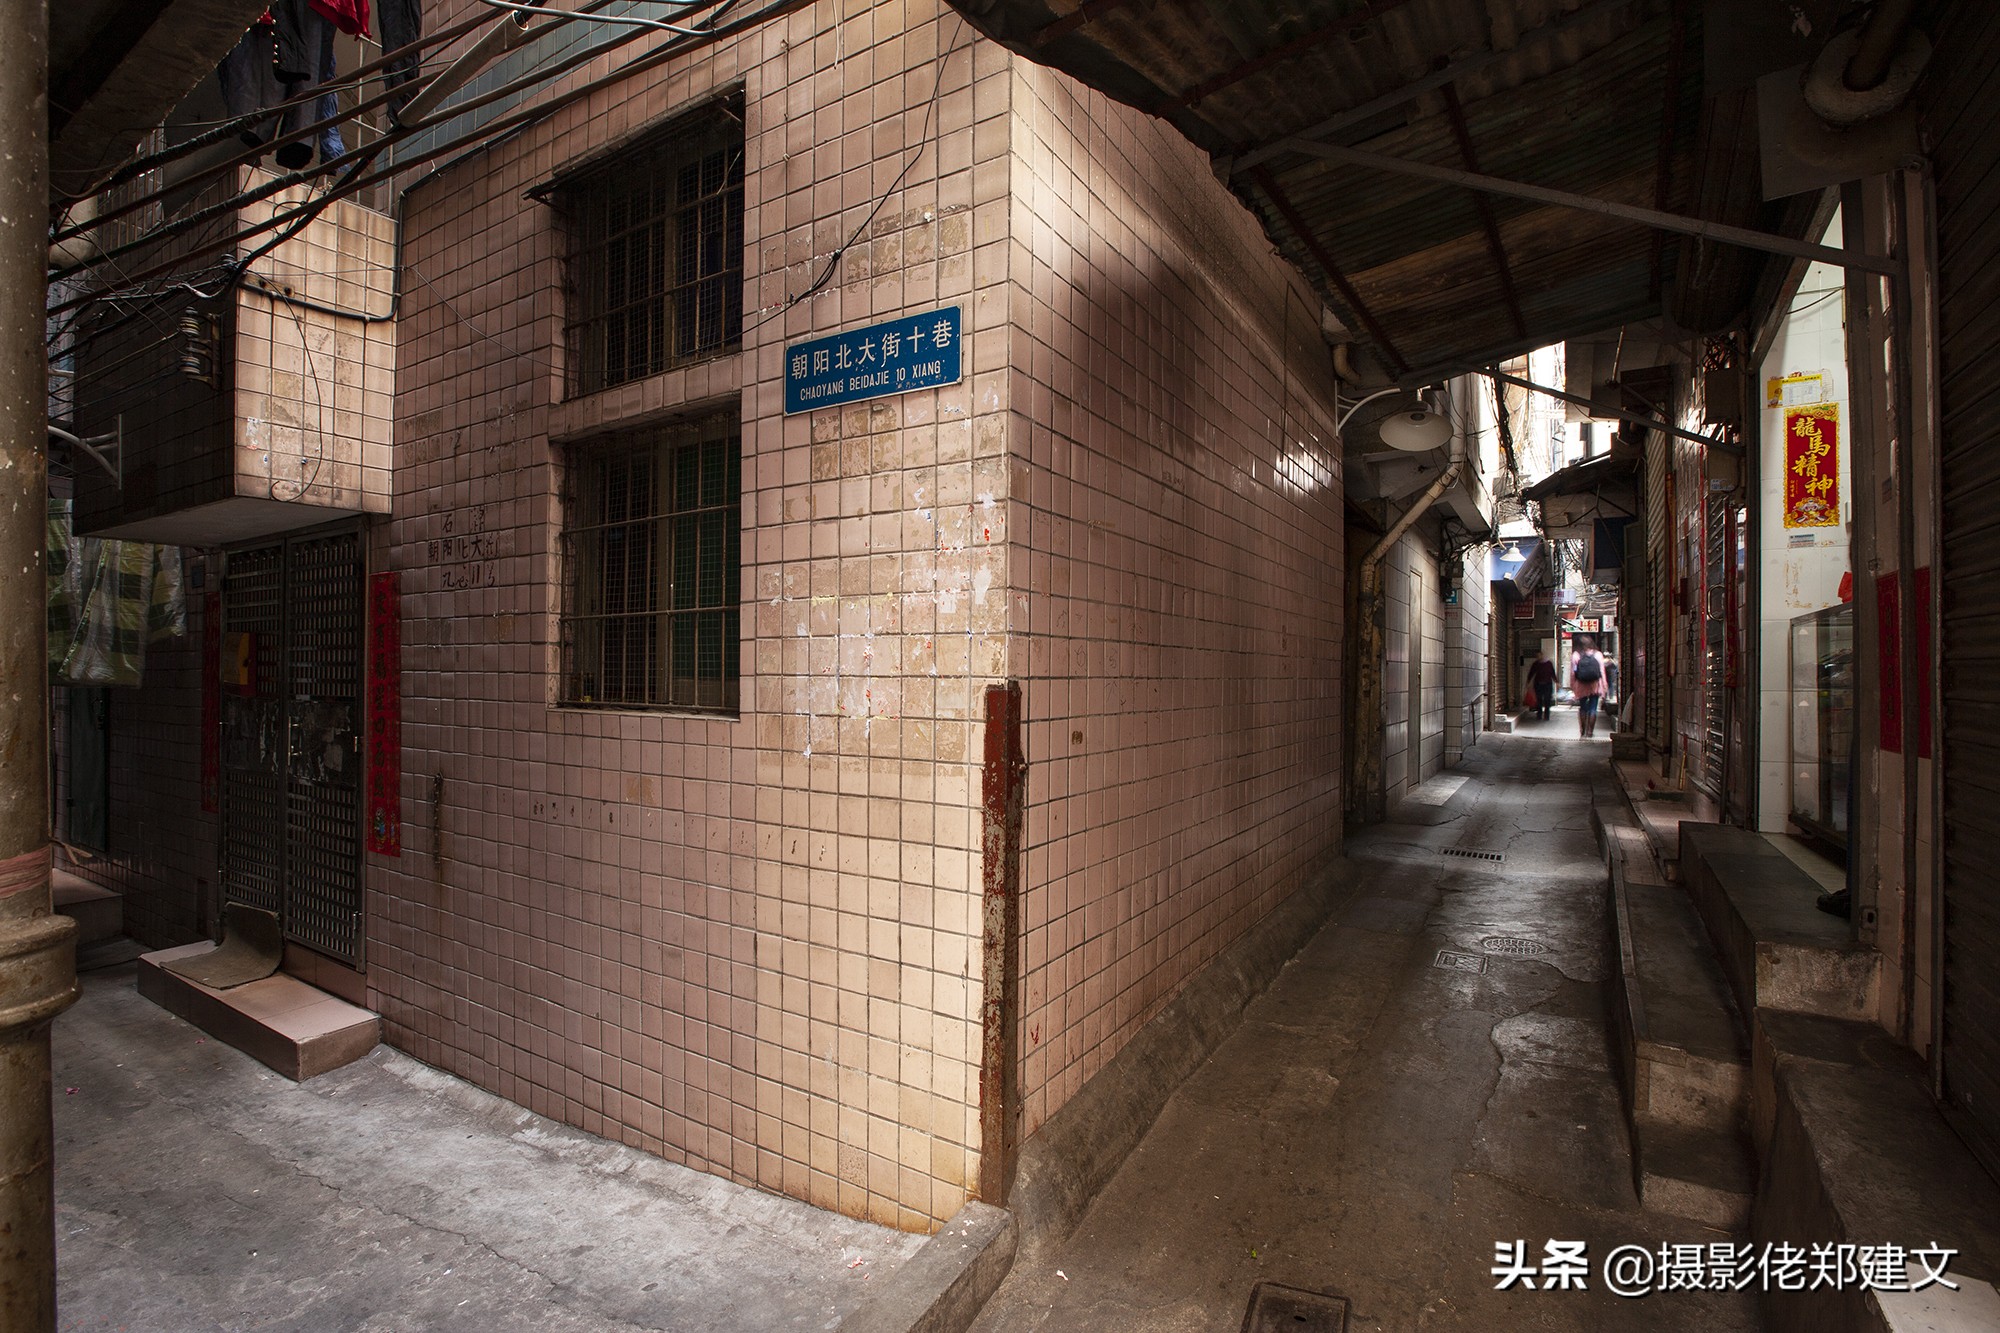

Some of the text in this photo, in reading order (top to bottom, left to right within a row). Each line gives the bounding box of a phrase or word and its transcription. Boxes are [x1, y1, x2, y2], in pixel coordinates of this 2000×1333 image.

[791, 319, 953, 380] 朝阳北大街十巷
[799, 378, 844, 401] CHAOYANG
[849, 370, 889, 392] BEIDAJIE
[896, 366, 906, 382] 10
[912, 360, 941, 379] XIANG
[1791, 416, 1834, 498] 龍馬精神
